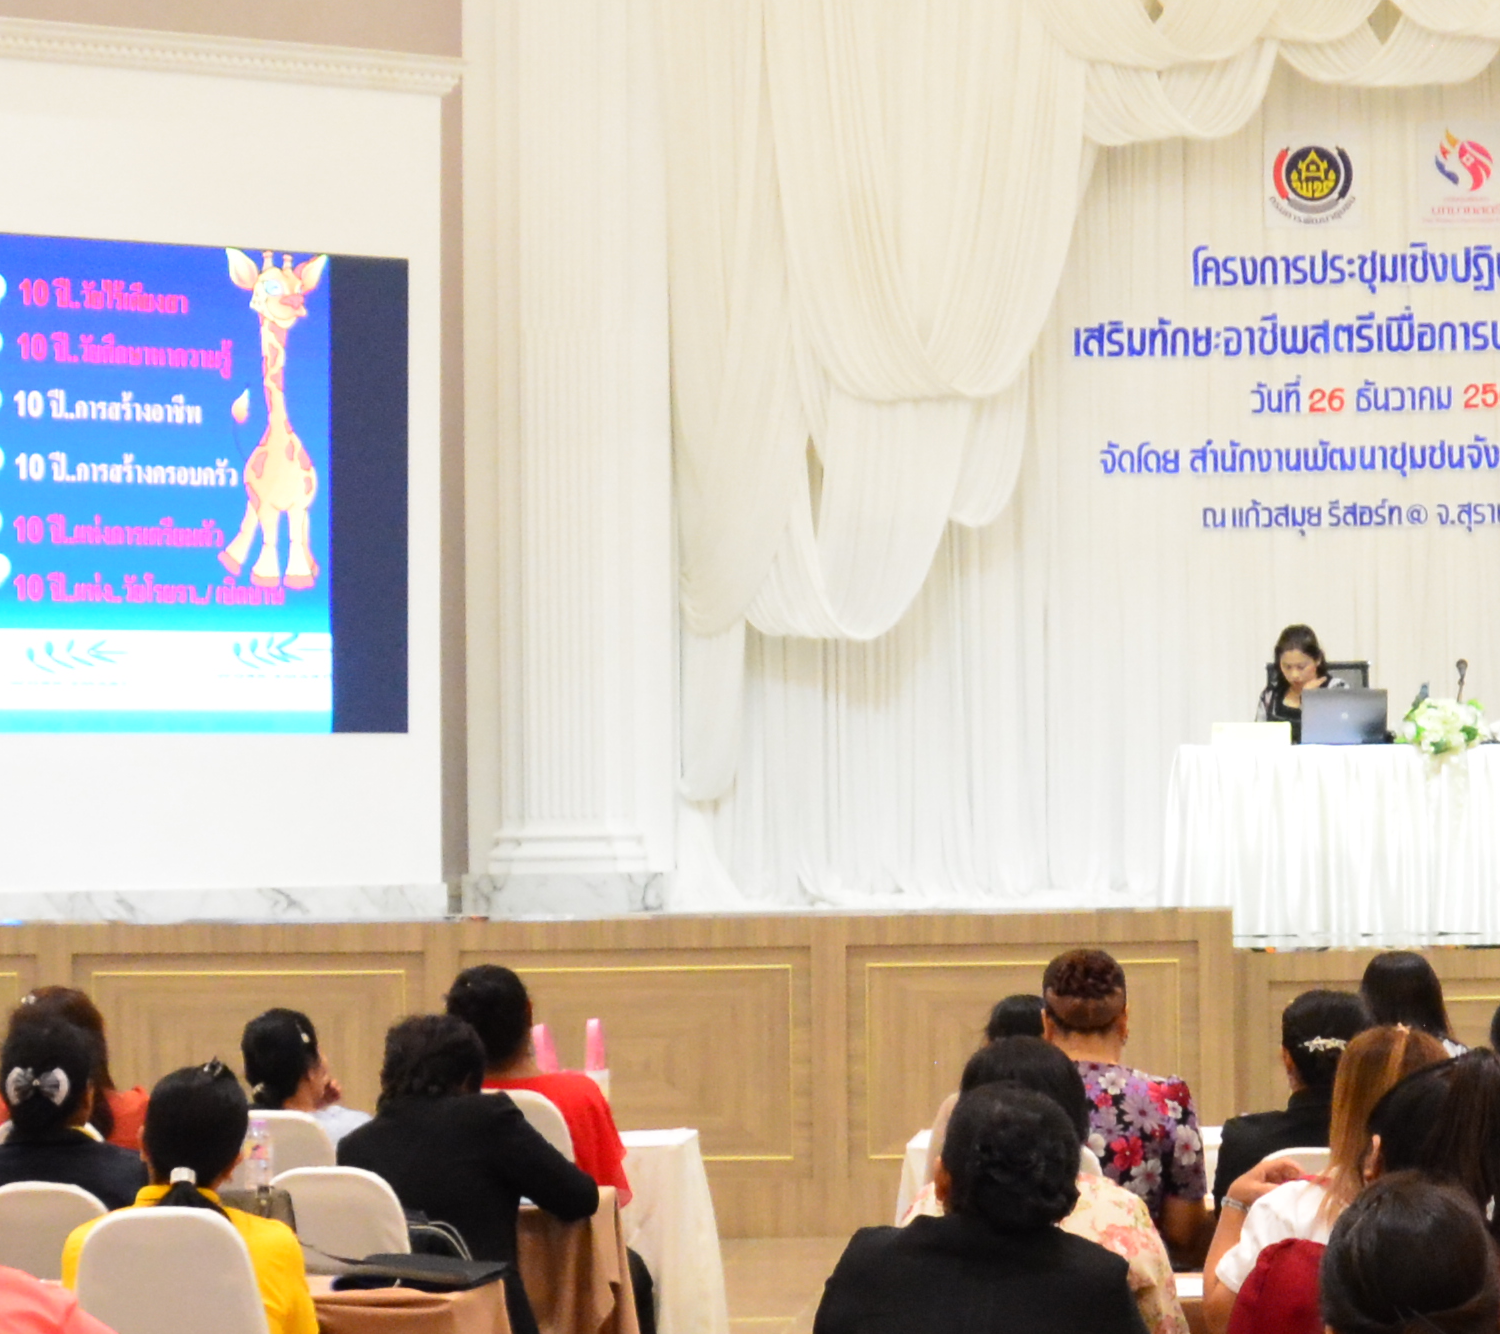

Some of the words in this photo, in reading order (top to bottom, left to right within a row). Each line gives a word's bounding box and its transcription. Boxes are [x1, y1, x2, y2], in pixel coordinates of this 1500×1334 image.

[19, 278, 49, 306] 10
[17, 332, 48, 361] 10
[13, 389, 44, 418] 10
[1251, 375, 1301, 414] วันที่
[1308, 386, 1346, 414] 26
[1355, 379, 1453, 413] ธันวาคม
[15, 452, 45, 481] 10
[1100, 440, 1181, 475] จัดโดย
[14, 515, 44, 543] 10
[14, 573, 44, 602] 10
